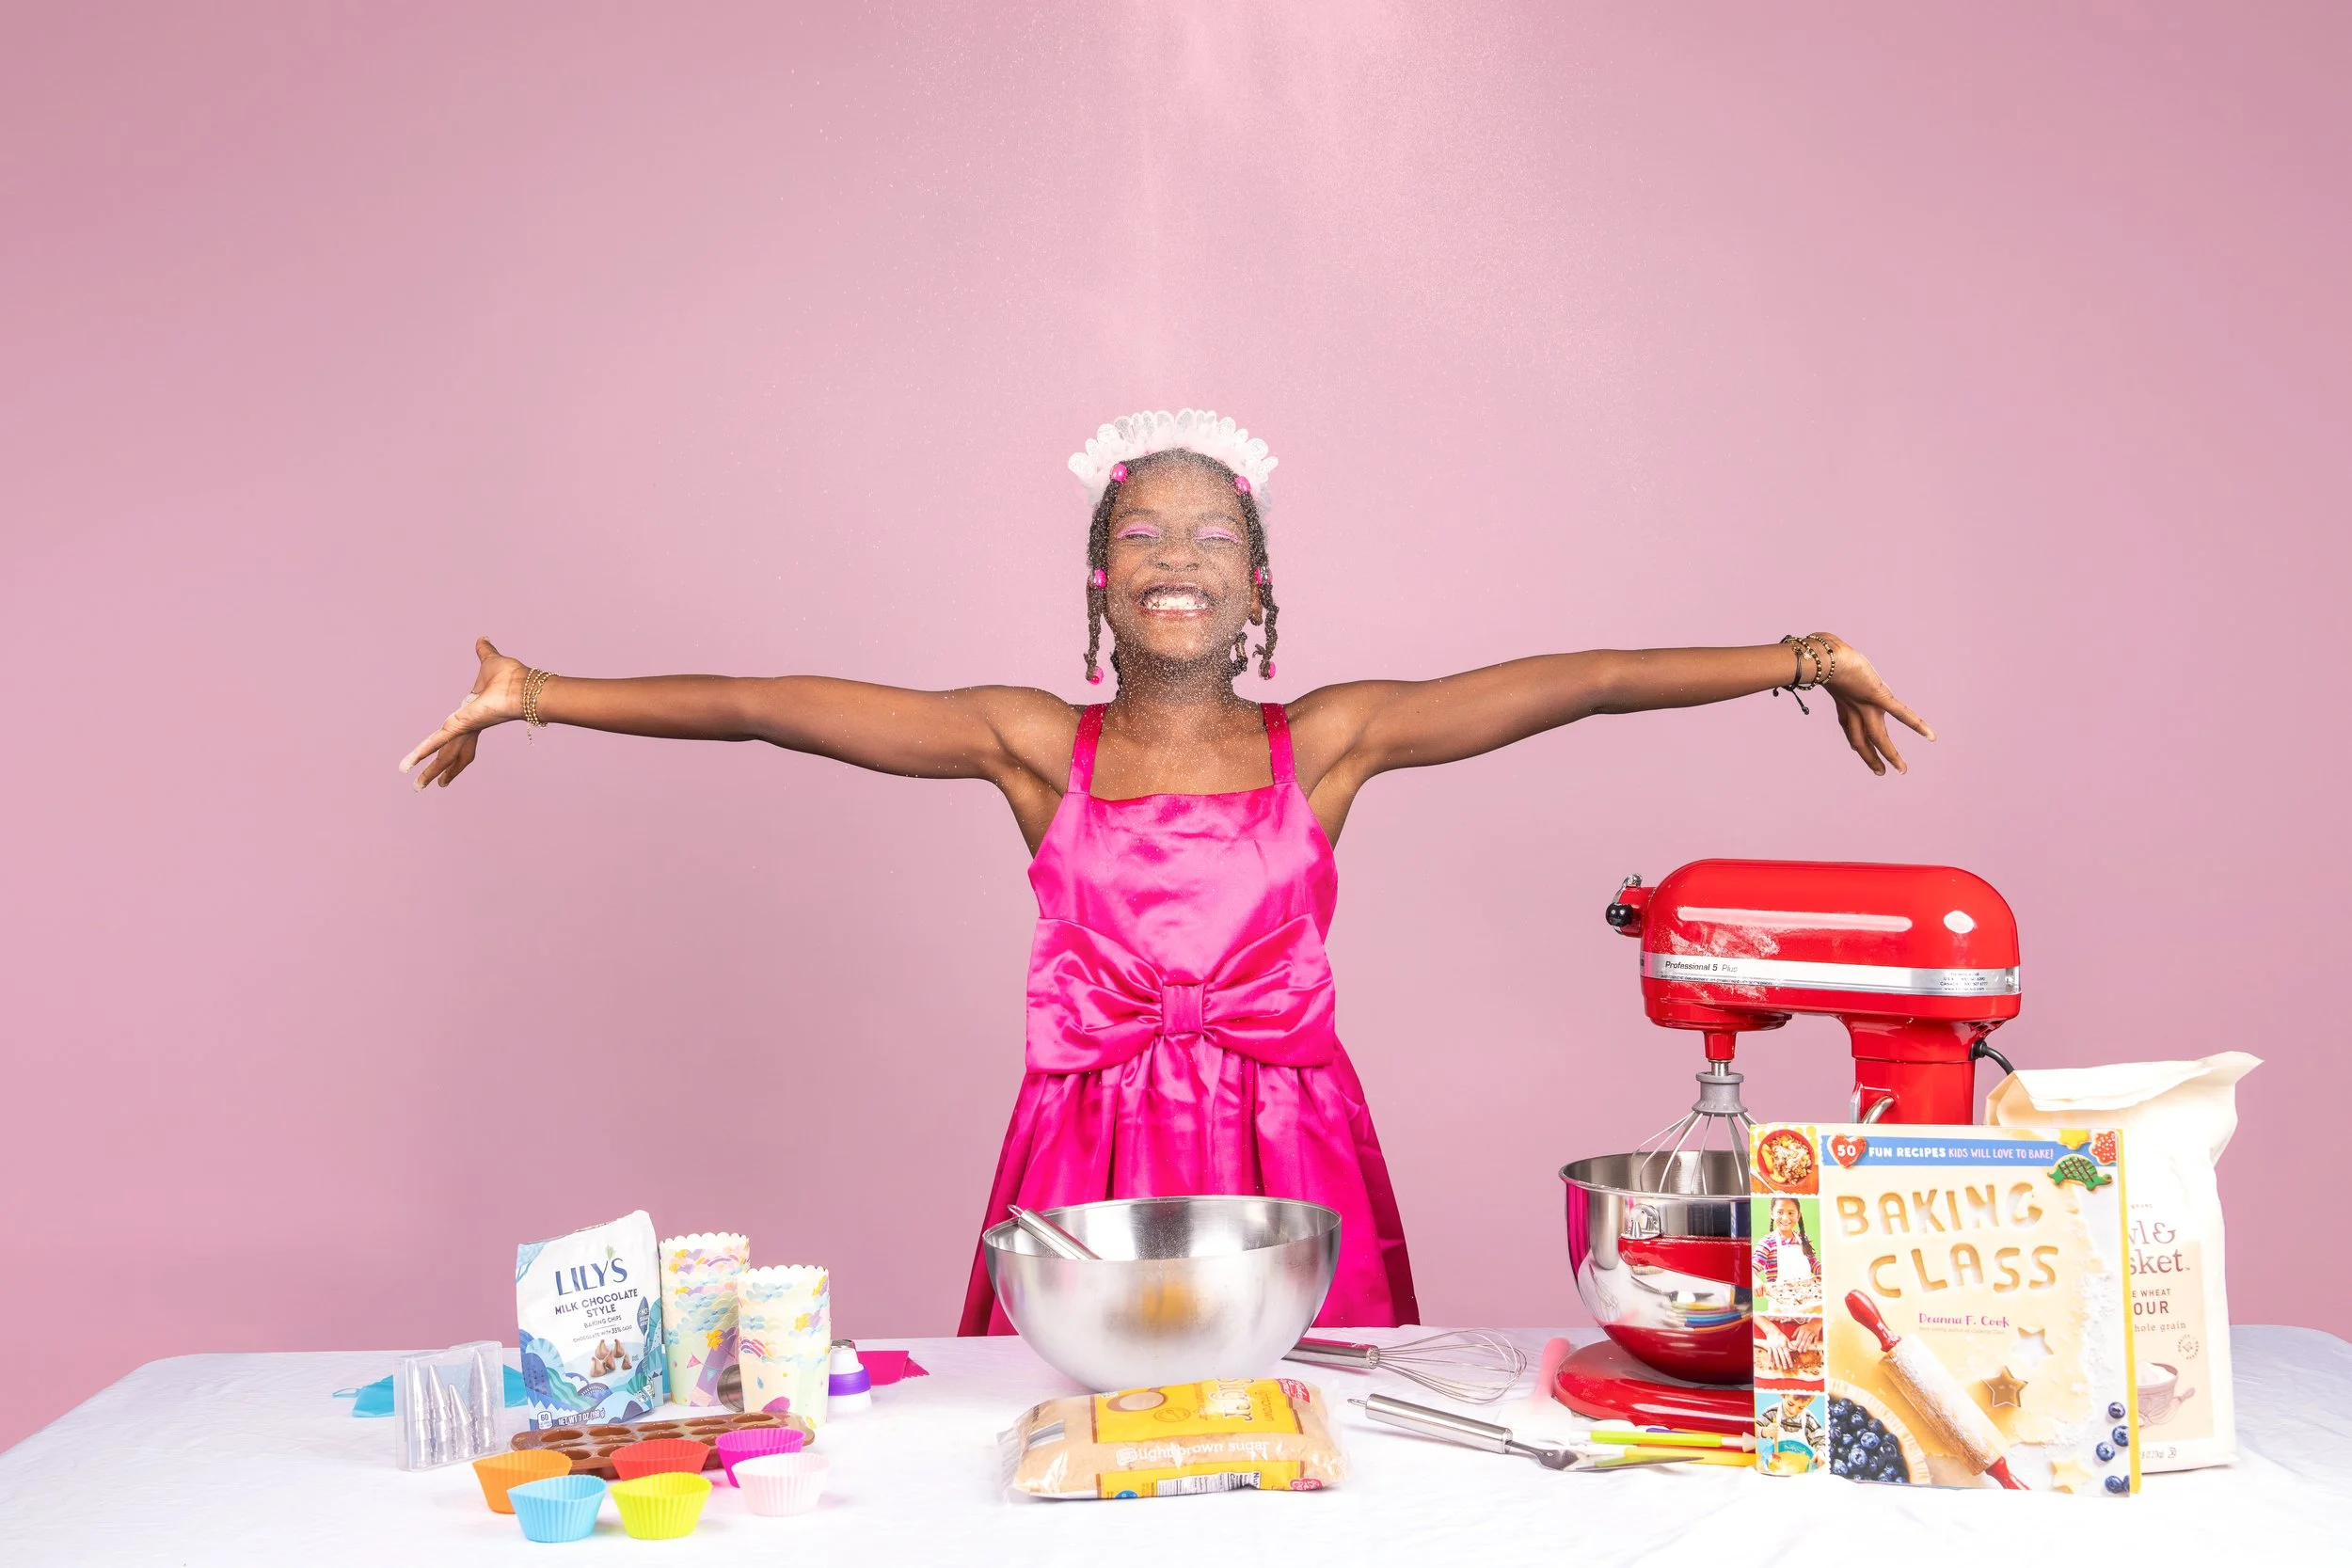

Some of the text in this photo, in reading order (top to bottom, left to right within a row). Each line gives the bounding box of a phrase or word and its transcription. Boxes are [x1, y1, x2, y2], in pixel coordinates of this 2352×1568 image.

[1665, 960, 1710, 971] Professional
[1722, 963, 1738, 973] Plus
[1836, 1145, 1856, 1156] 50
[1868, 1147, 2054, 1160] FUN RECIPES KIDS WILL LOVE TO BAKE!
[1836, 1181, 2044, 1238] BAKING
[1867, 1243, 2059, 1298] CLASS
[2140, 1288, 2171, 1297] WHEAT
[554, 1288, 638, 1315] MILK CHOCOLATE
[2133, 1300, 2169, 1316] OUR
[586, 1304, 617, 1318] STYLE
[583, 1314, 623, 1329] BAKING CHIPS
[1918, 1311, 2010, 1328] Deanna F. Cook
[2134, 1321, 2186, 1333] hole grain
[573, 1332, 600, 1343] CHOCOLATE
[540, 1413, 549, 1421] 60
[558, 1417, 568, 1426] NET
[568, 1415, 578, 1424] WT
[582, 1412, 590, 1420] OZ
[1138, 1440, 1270, 1461] light brown sugar
